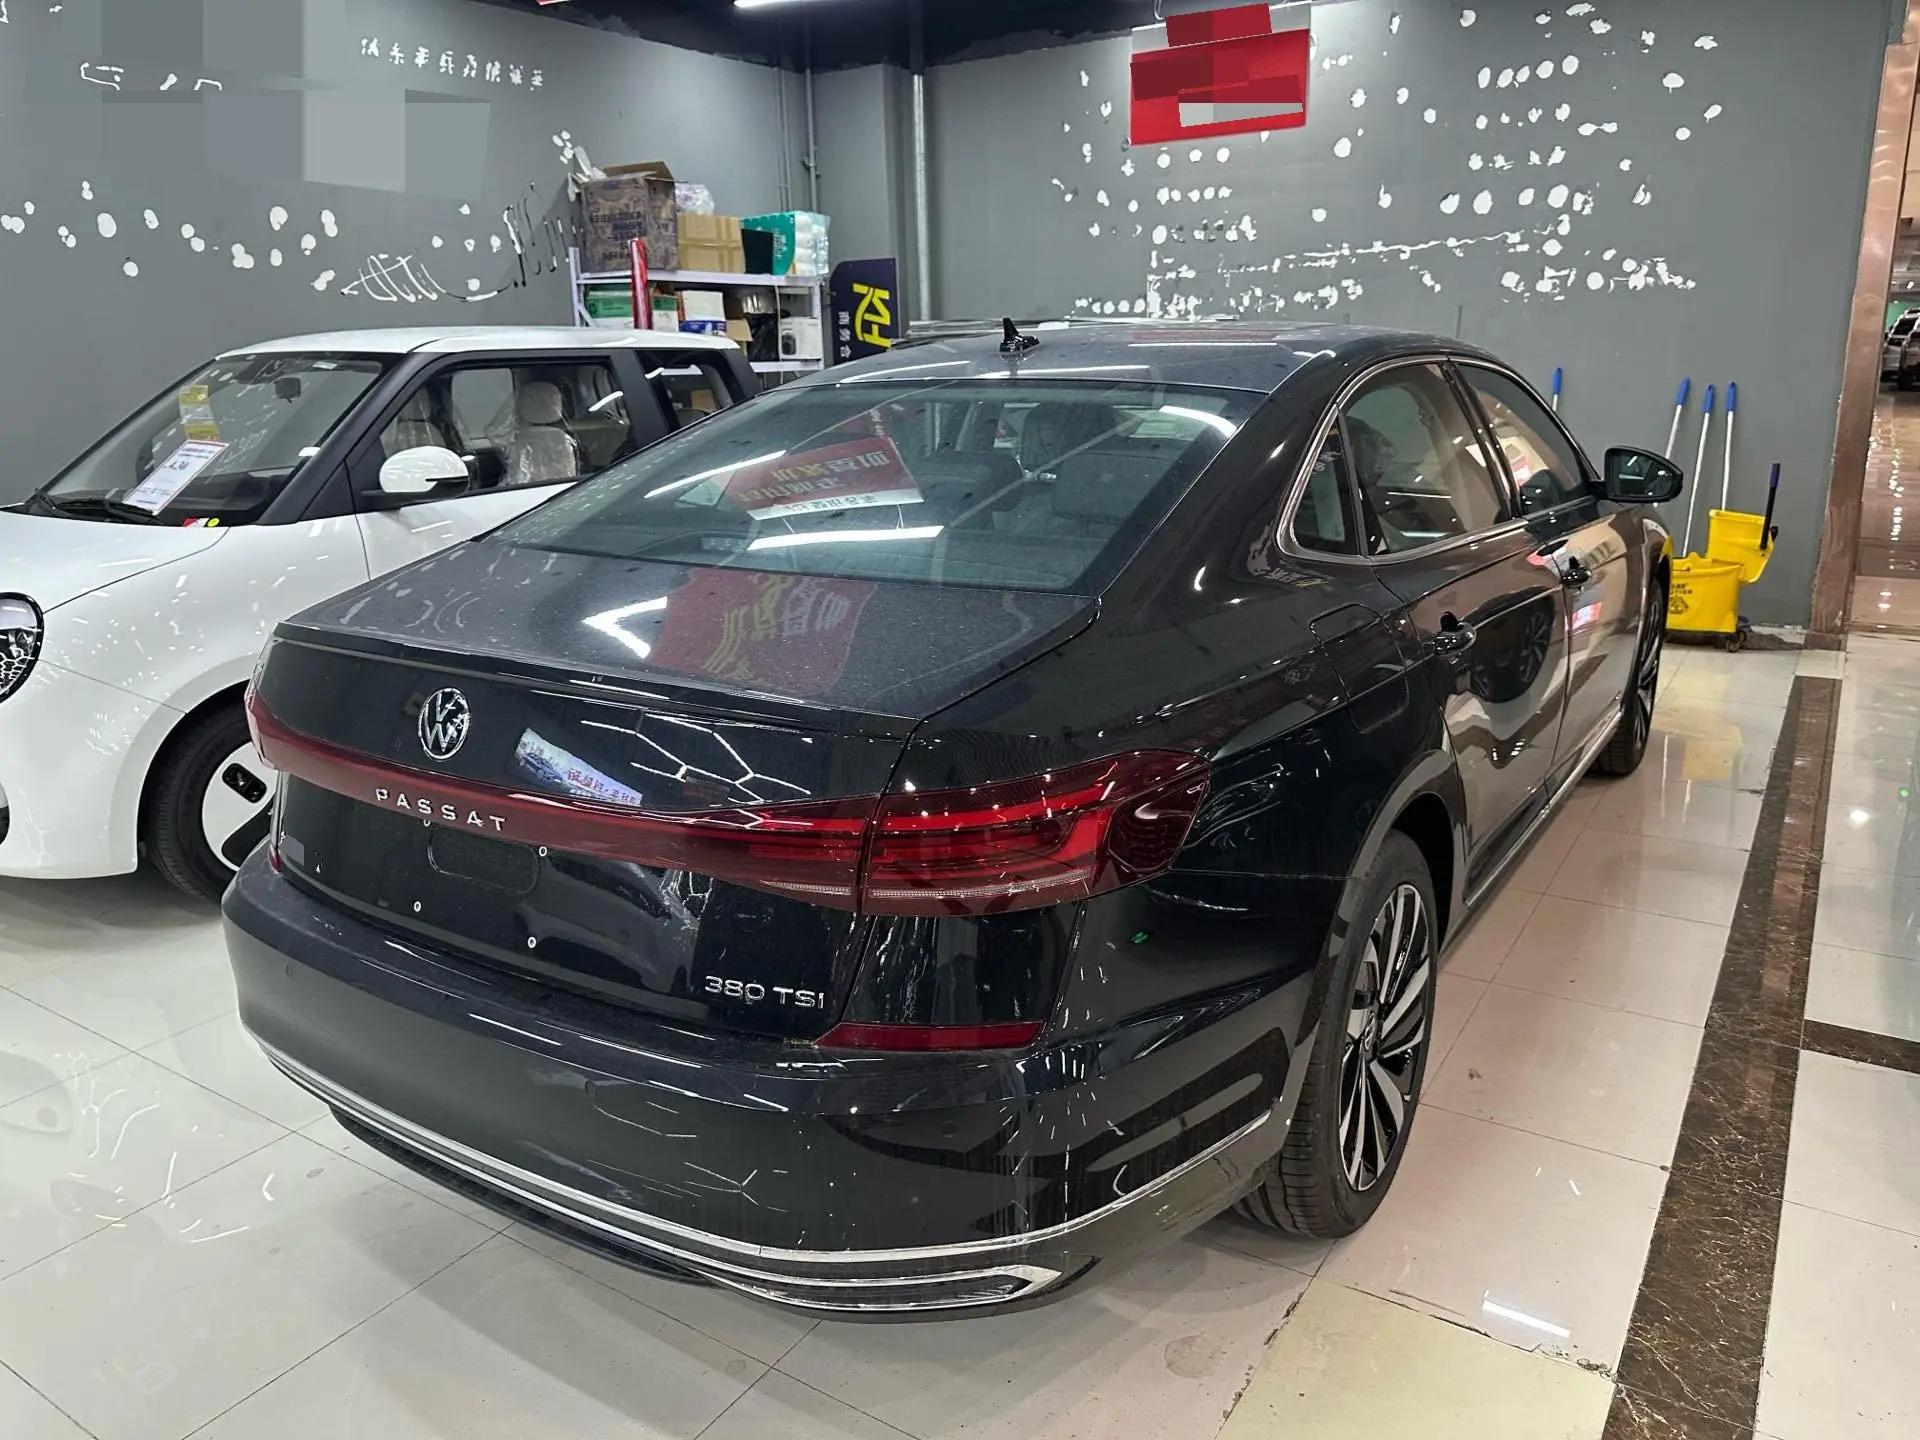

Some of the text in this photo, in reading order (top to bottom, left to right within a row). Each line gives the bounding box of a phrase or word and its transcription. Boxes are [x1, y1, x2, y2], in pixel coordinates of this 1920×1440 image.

[375, 788, 506, 831] PASSAT
[704, 975, 825, 1009] 380 TSI
